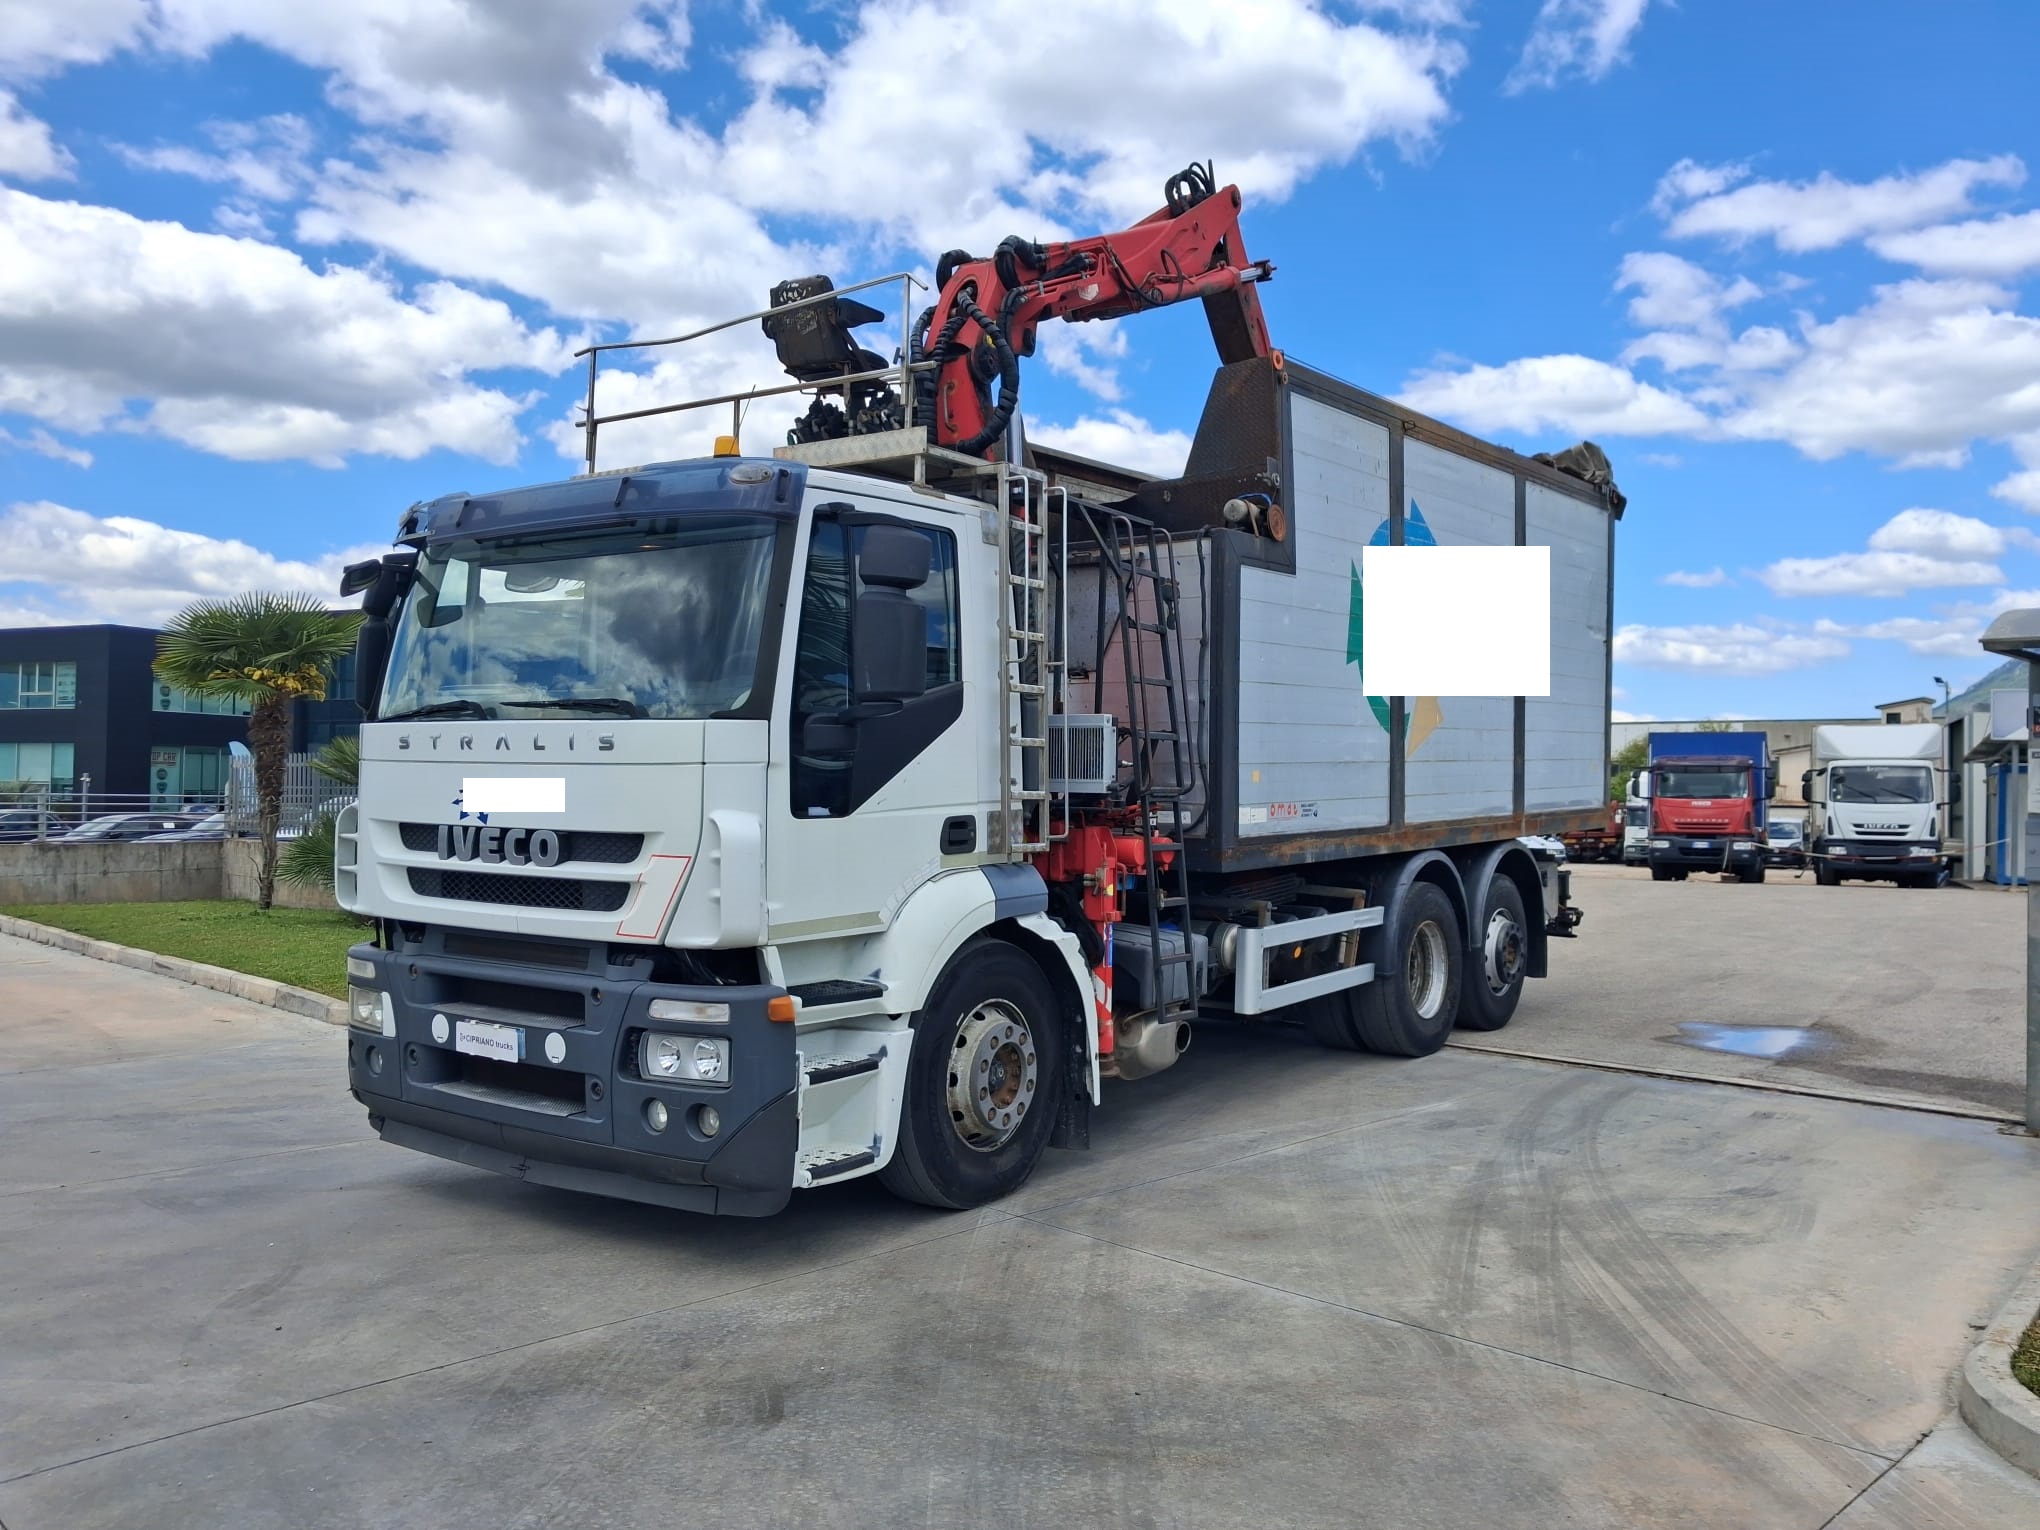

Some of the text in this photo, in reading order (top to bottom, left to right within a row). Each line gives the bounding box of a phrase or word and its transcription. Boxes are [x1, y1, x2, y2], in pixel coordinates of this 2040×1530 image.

[398, 732, 615, 751] STRALIS
[437, 825, 561, 867] IVECO
[465, 1034, 513, 1051] CIPRIANO trucks
